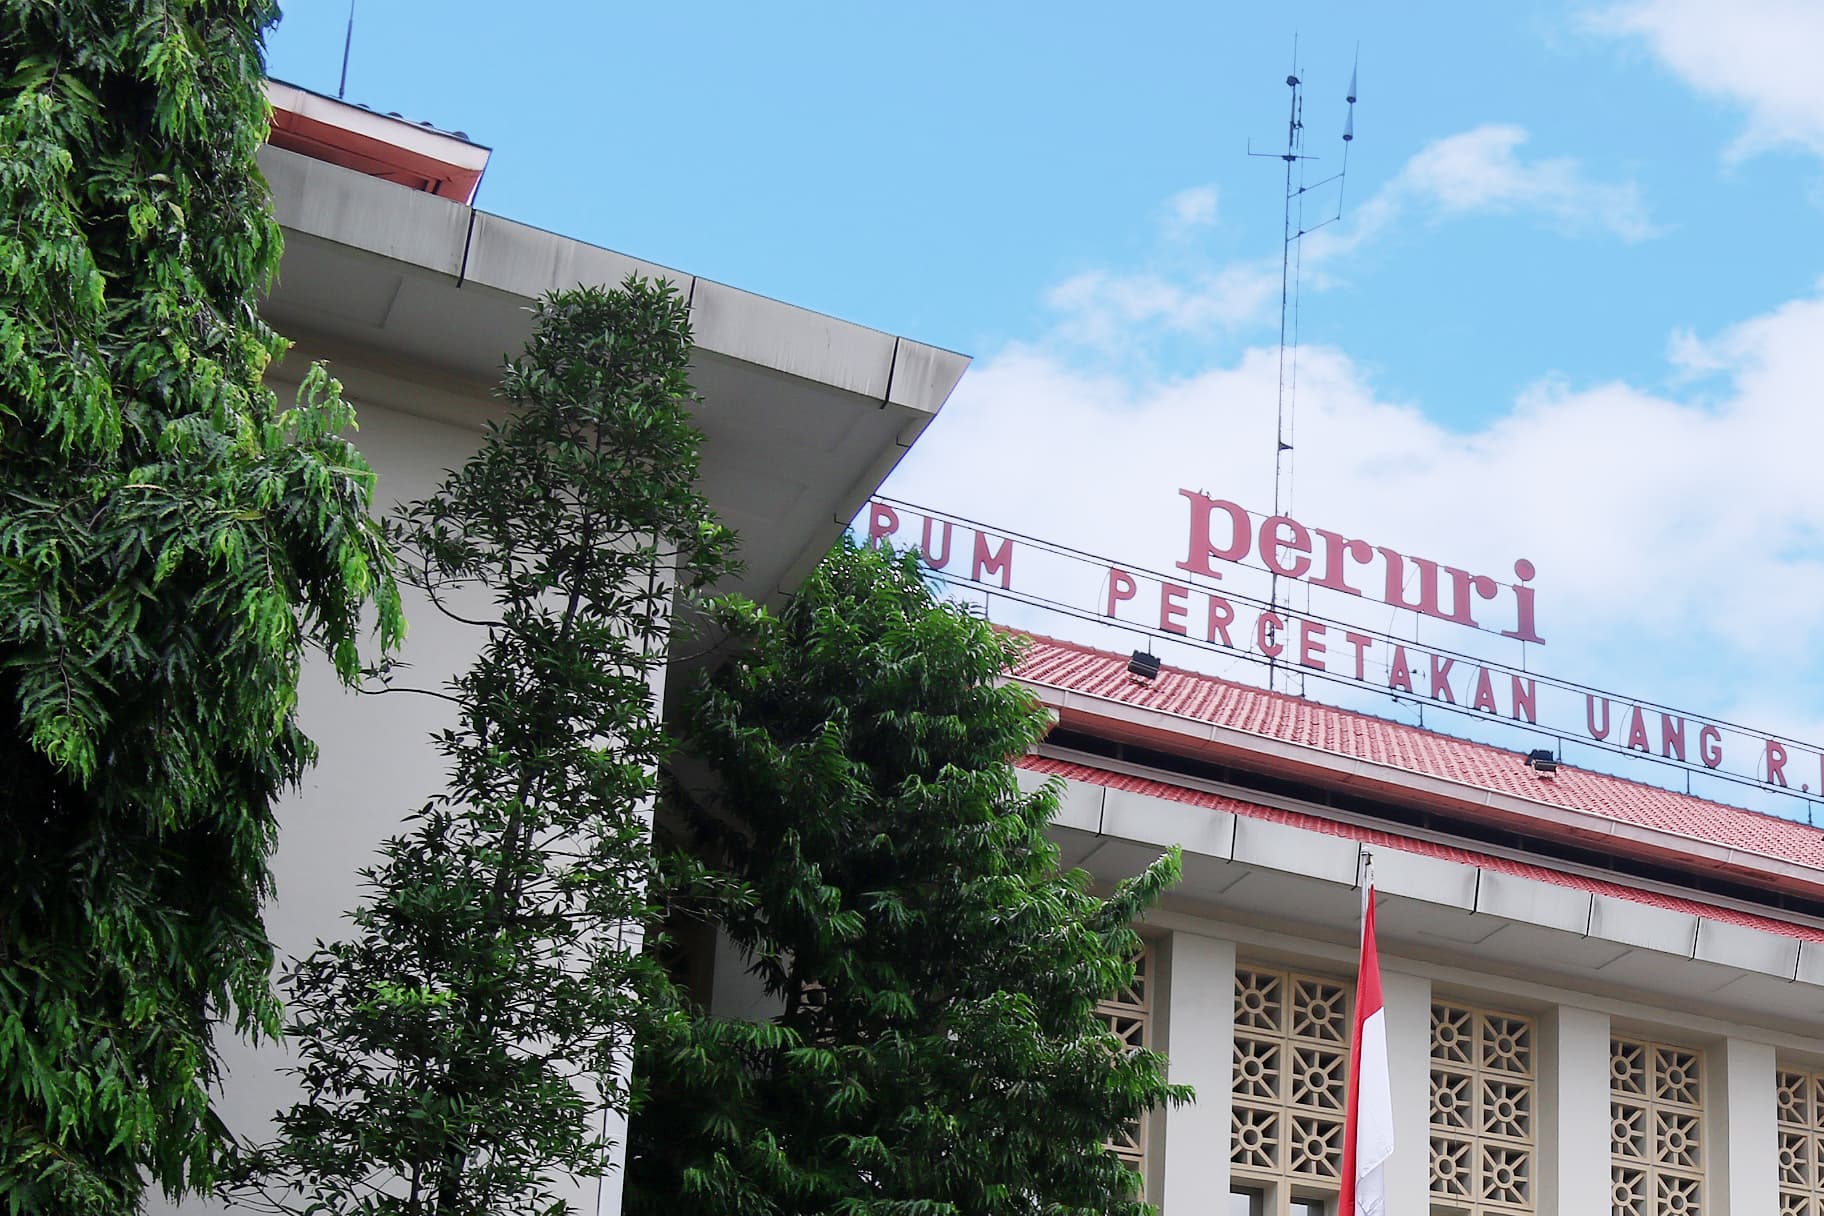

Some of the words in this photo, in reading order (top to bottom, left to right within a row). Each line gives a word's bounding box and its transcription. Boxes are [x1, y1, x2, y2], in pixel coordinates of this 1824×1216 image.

[1175, 487, 1546, 646] peruri
[1107, 566, 1537, 725] PERCETAKAN
[1586, 693, 1723, 768] UANG
